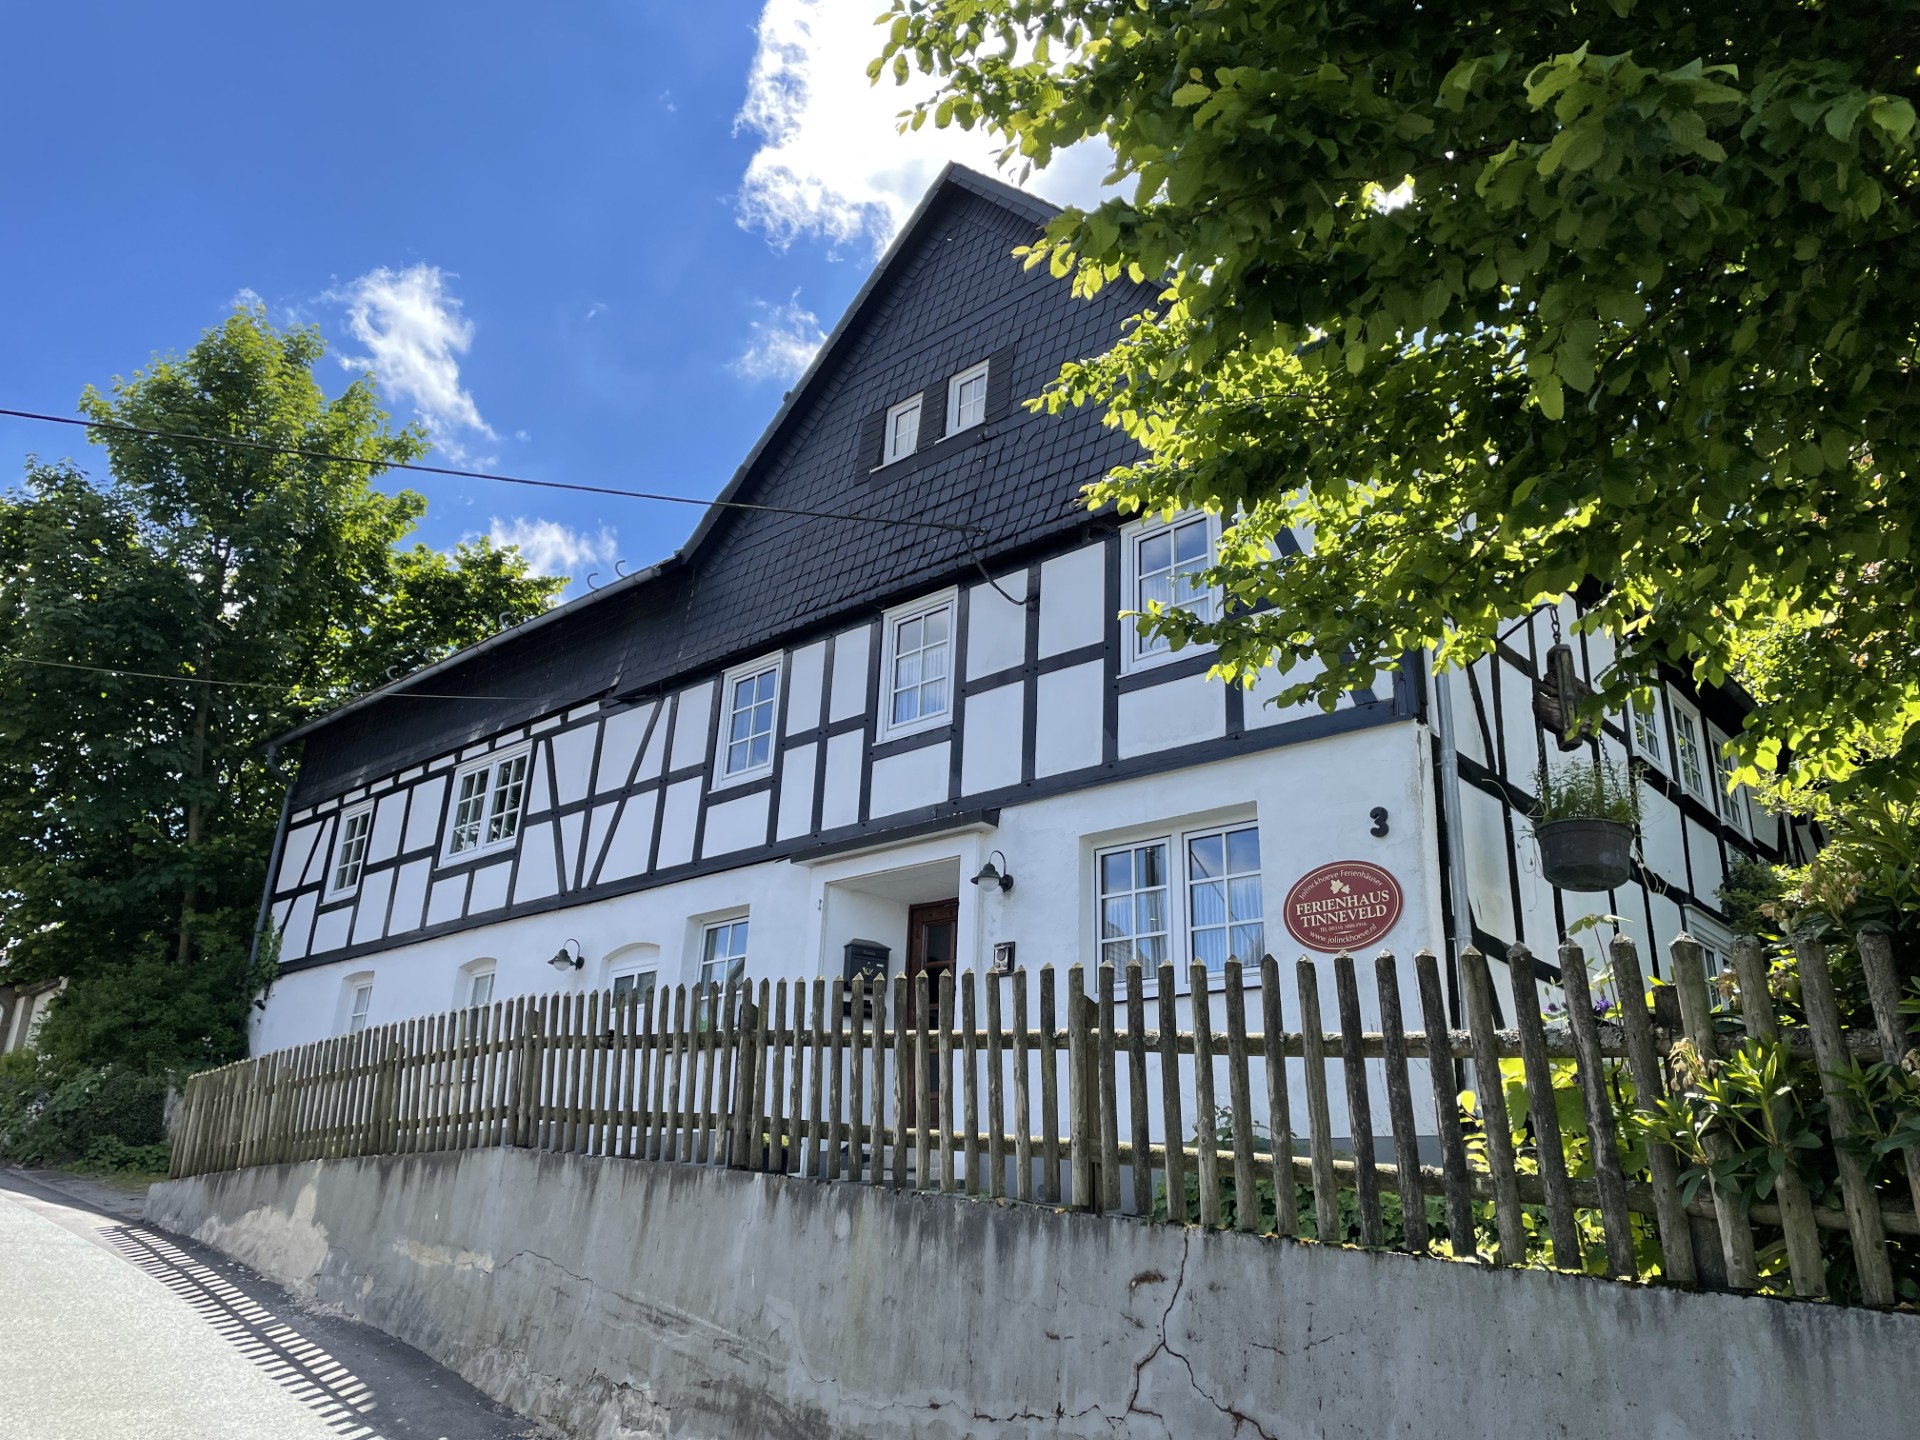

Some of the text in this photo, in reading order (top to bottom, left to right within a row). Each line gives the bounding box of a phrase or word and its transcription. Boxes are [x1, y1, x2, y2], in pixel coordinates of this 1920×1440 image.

[1370, 806, 1389, 837] 3
[1298, 869, 1383, 900] Jolinckhoeve Ferienhäuser
[1296, 890, 1390, 916] FERIENHAUS
[1300, 904, 1387, 928] TINNEVELD
[1309, 923, 1377, 944] www.jolinckhoeve.nl
